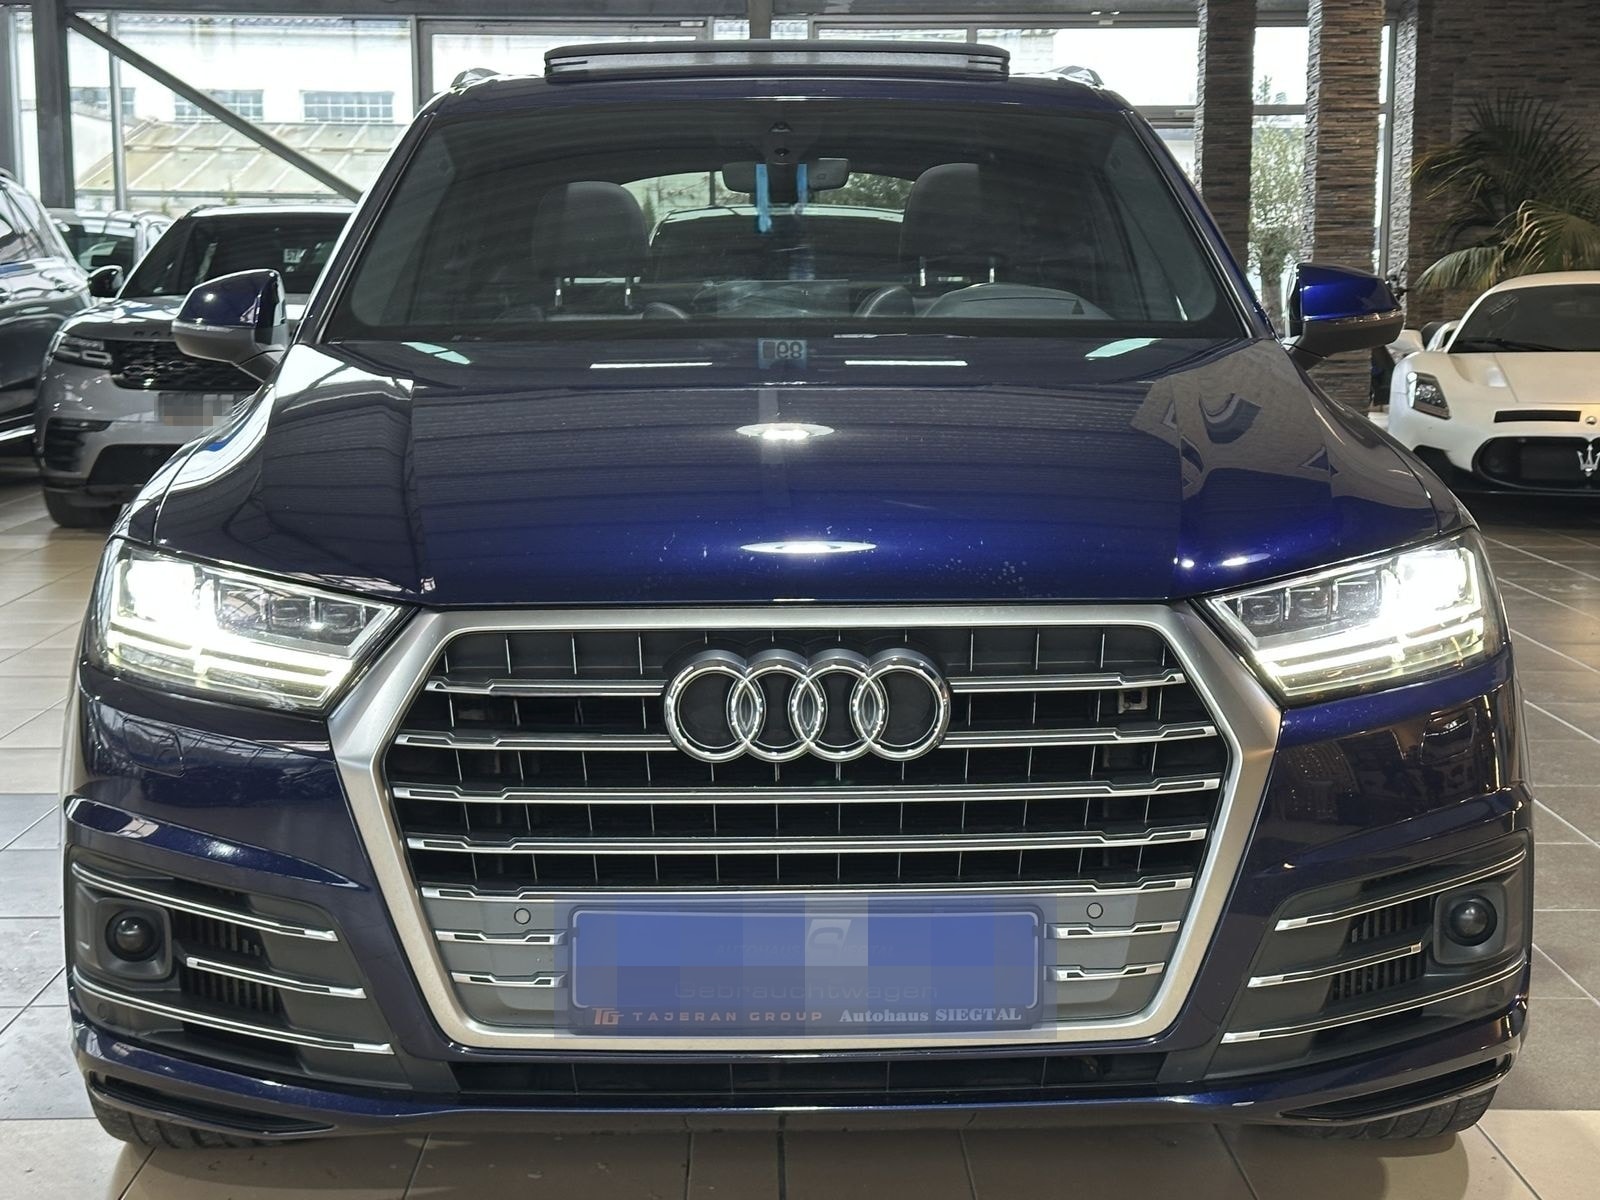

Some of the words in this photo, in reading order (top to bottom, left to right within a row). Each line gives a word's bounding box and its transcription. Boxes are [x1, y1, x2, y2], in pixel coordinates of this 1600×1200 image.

[673, 981, 939, 1002] Gebrauchtwagen
[633, 1012, 737, 1022] TAJERAN
[749, 1012, 823, 1022] GROUP
[839, 1009, 929, 1023] Autohaus
[935, 1008, 1021, 1022] SIEGTAL
